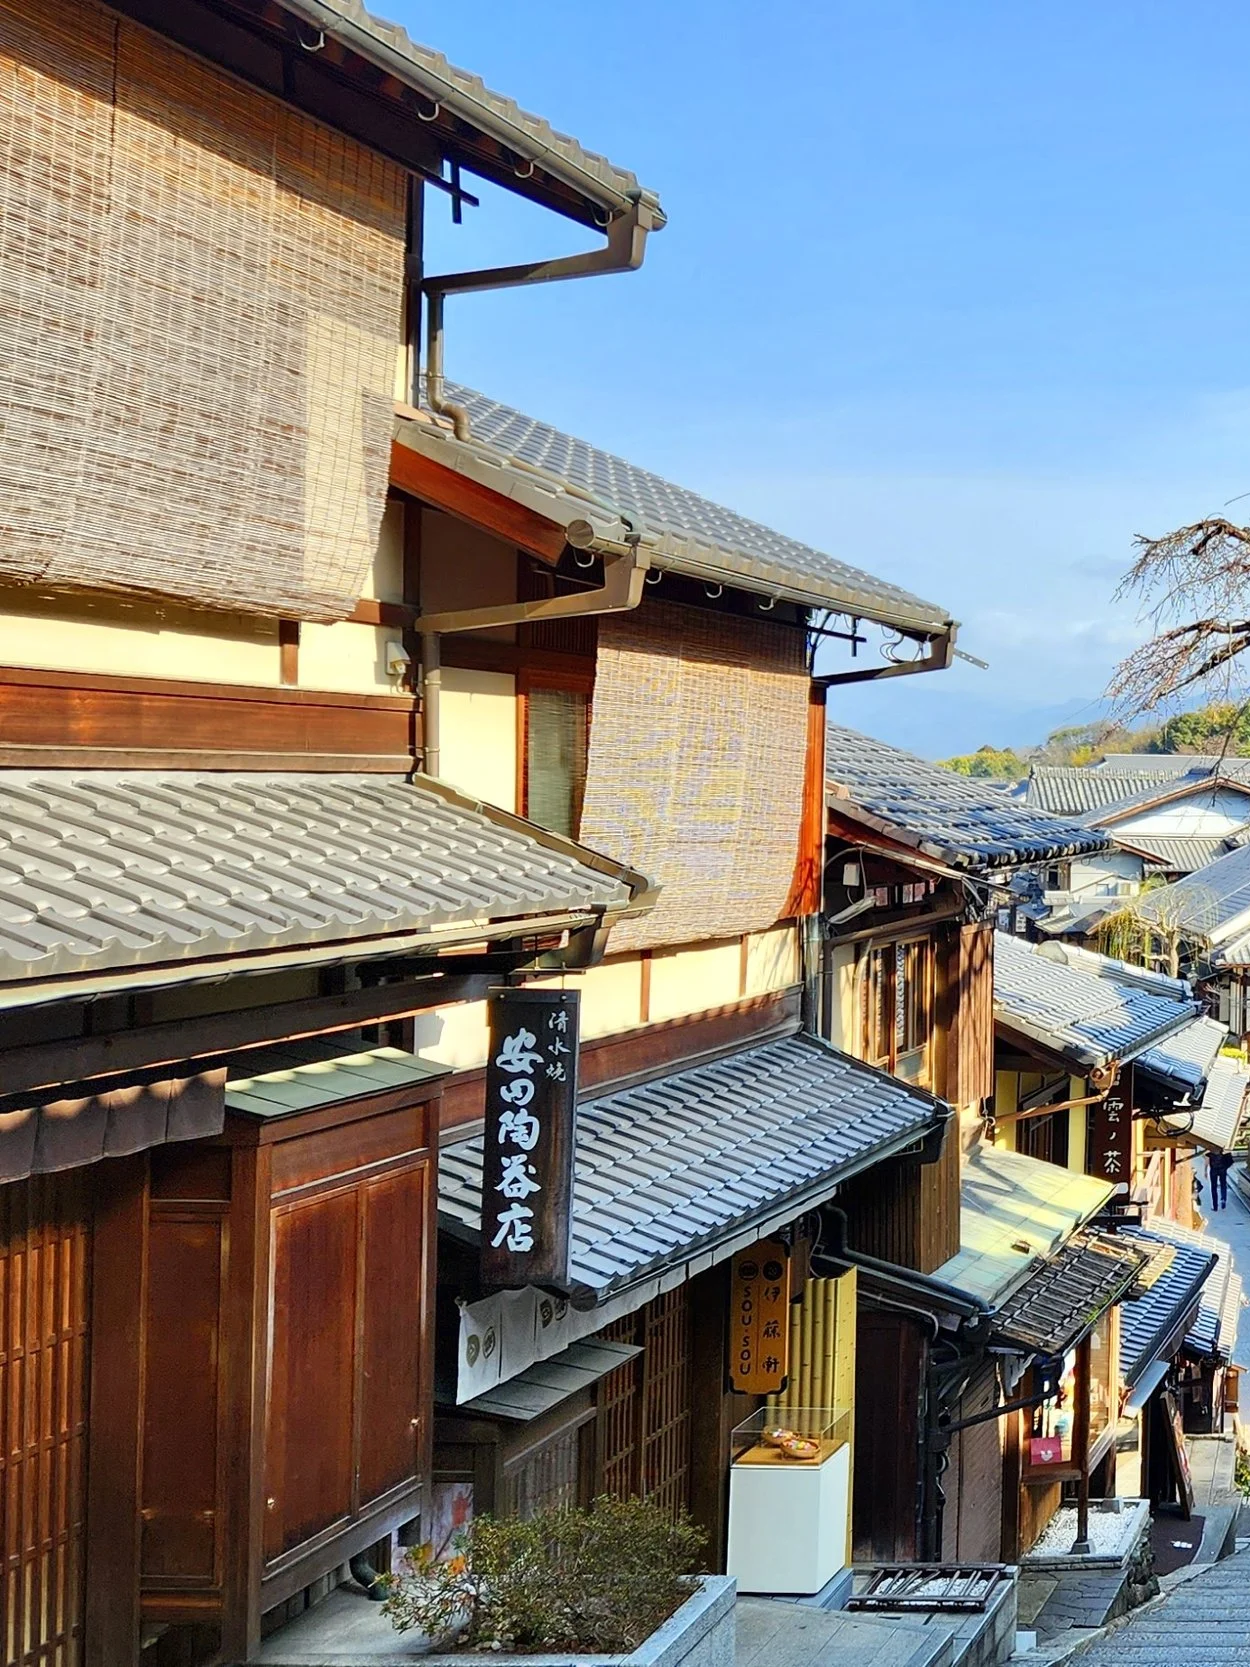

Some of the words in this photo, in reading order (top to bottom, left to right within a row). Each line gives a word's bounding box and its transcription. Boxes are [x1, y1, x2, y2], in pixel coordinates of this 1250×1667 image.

[545, 1010, 571, 1083] 清水焼
[490, 1027, 545, 1253] 安田陶器店
[762, 1286, 781, 1374] 伊藤軒
